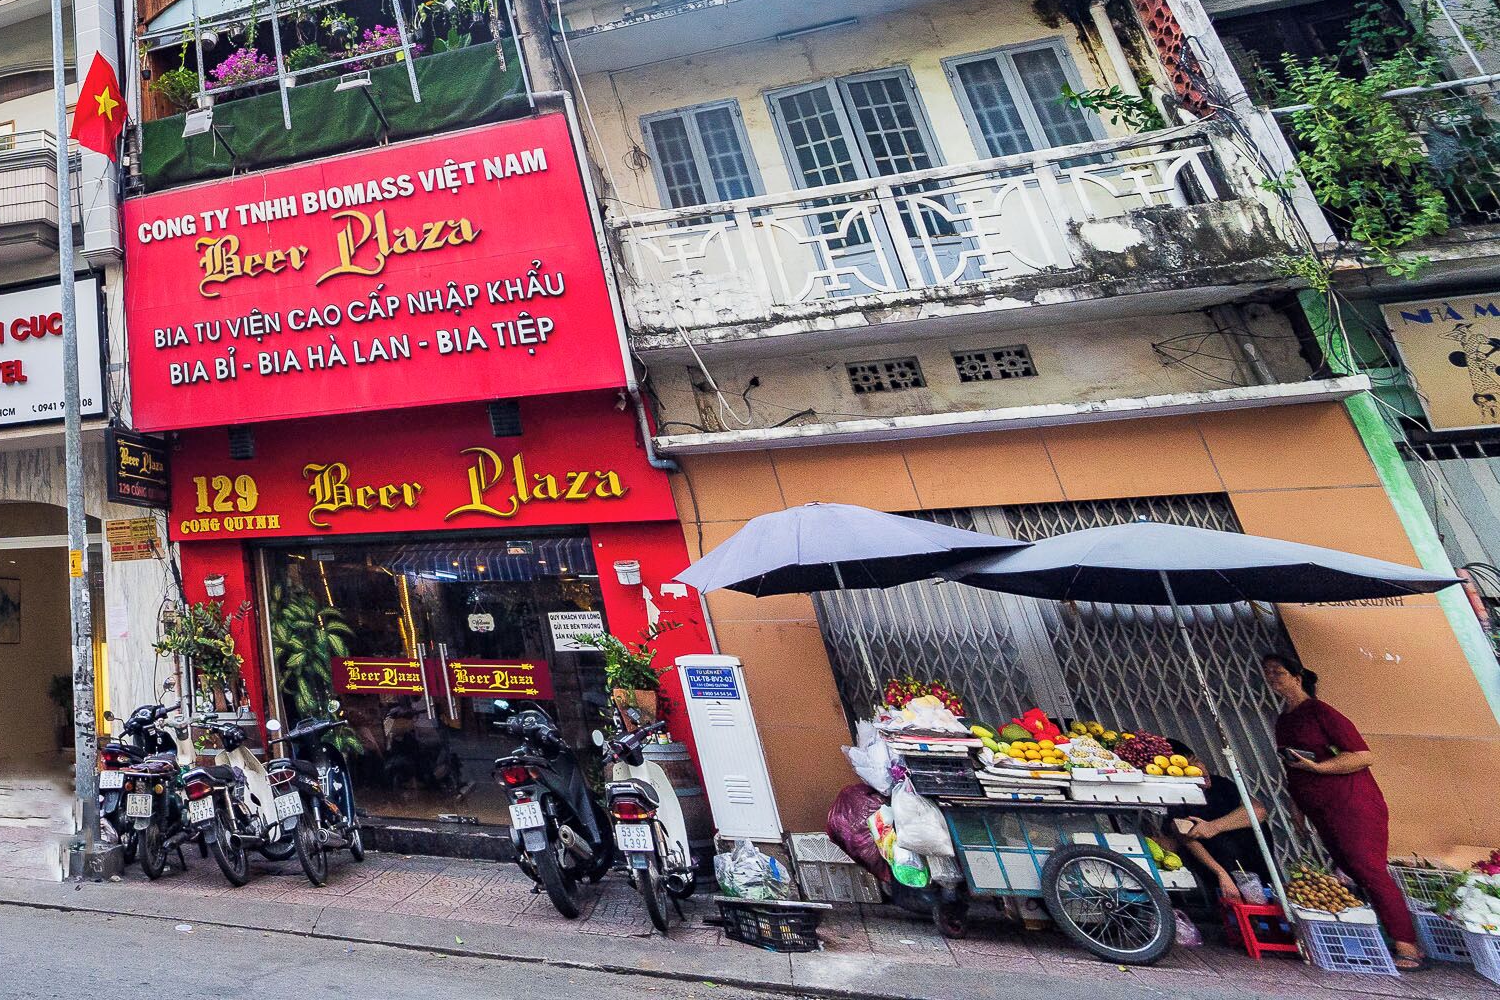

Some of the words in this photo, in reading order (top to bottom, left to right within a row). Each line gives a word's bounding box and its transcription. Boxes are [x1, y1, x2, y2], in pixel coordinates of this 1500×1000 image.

[138, 214, 197, 244] CONG
[201, 207, 229, 232] TY
[235, 194, 298, 228] TNHH
[303, 174, 415, 216] BIOMASS
[417, 158, 478, 195] VIỆT
[483, 147, 548, 181] NAM
[195, 232, 309, 298] Beer
[316, 209, 483, 286] Plaza
[154, 325, 187, 349] BIA
[194, 318, 221, 343] TU
[225, 308, 281, 343] VIỆN
[287, 304, 342, 331] CAO
[347, 282, 401, 321] CẤP
[406, 279, 480, 317] NHẬP
[486, 259, 566, 303] KHẨU
[169, 360, 209, 386] BIA
[215, 346, 236, 380] BỈ
[258, 350, 301, 376] BIA
[307, 339, 349, 371] HÀ
[353, 334, 411, 366] LAN
[436, 326, 487, 355] BIA
[492, 311, 556, 355] TIỆP
[38, 402, 58, 412] 0941
[119, 446, 139, 469] Beer
[140, 452, 164, 474] Plaza
[119, 482, 130, 494] 129
[193, 475, 258, 514] 129
[303, 462, 423, 528] Beer
[444, 447, 629, 522] Plaza
[347, 667, 381, 687] Beer
[379, 668, 421, 686] Plaza
[453, 669, 490, 689] Beer
[489, 670, 534, 689] Plaza
[623, 838, 648, 849] 4392
